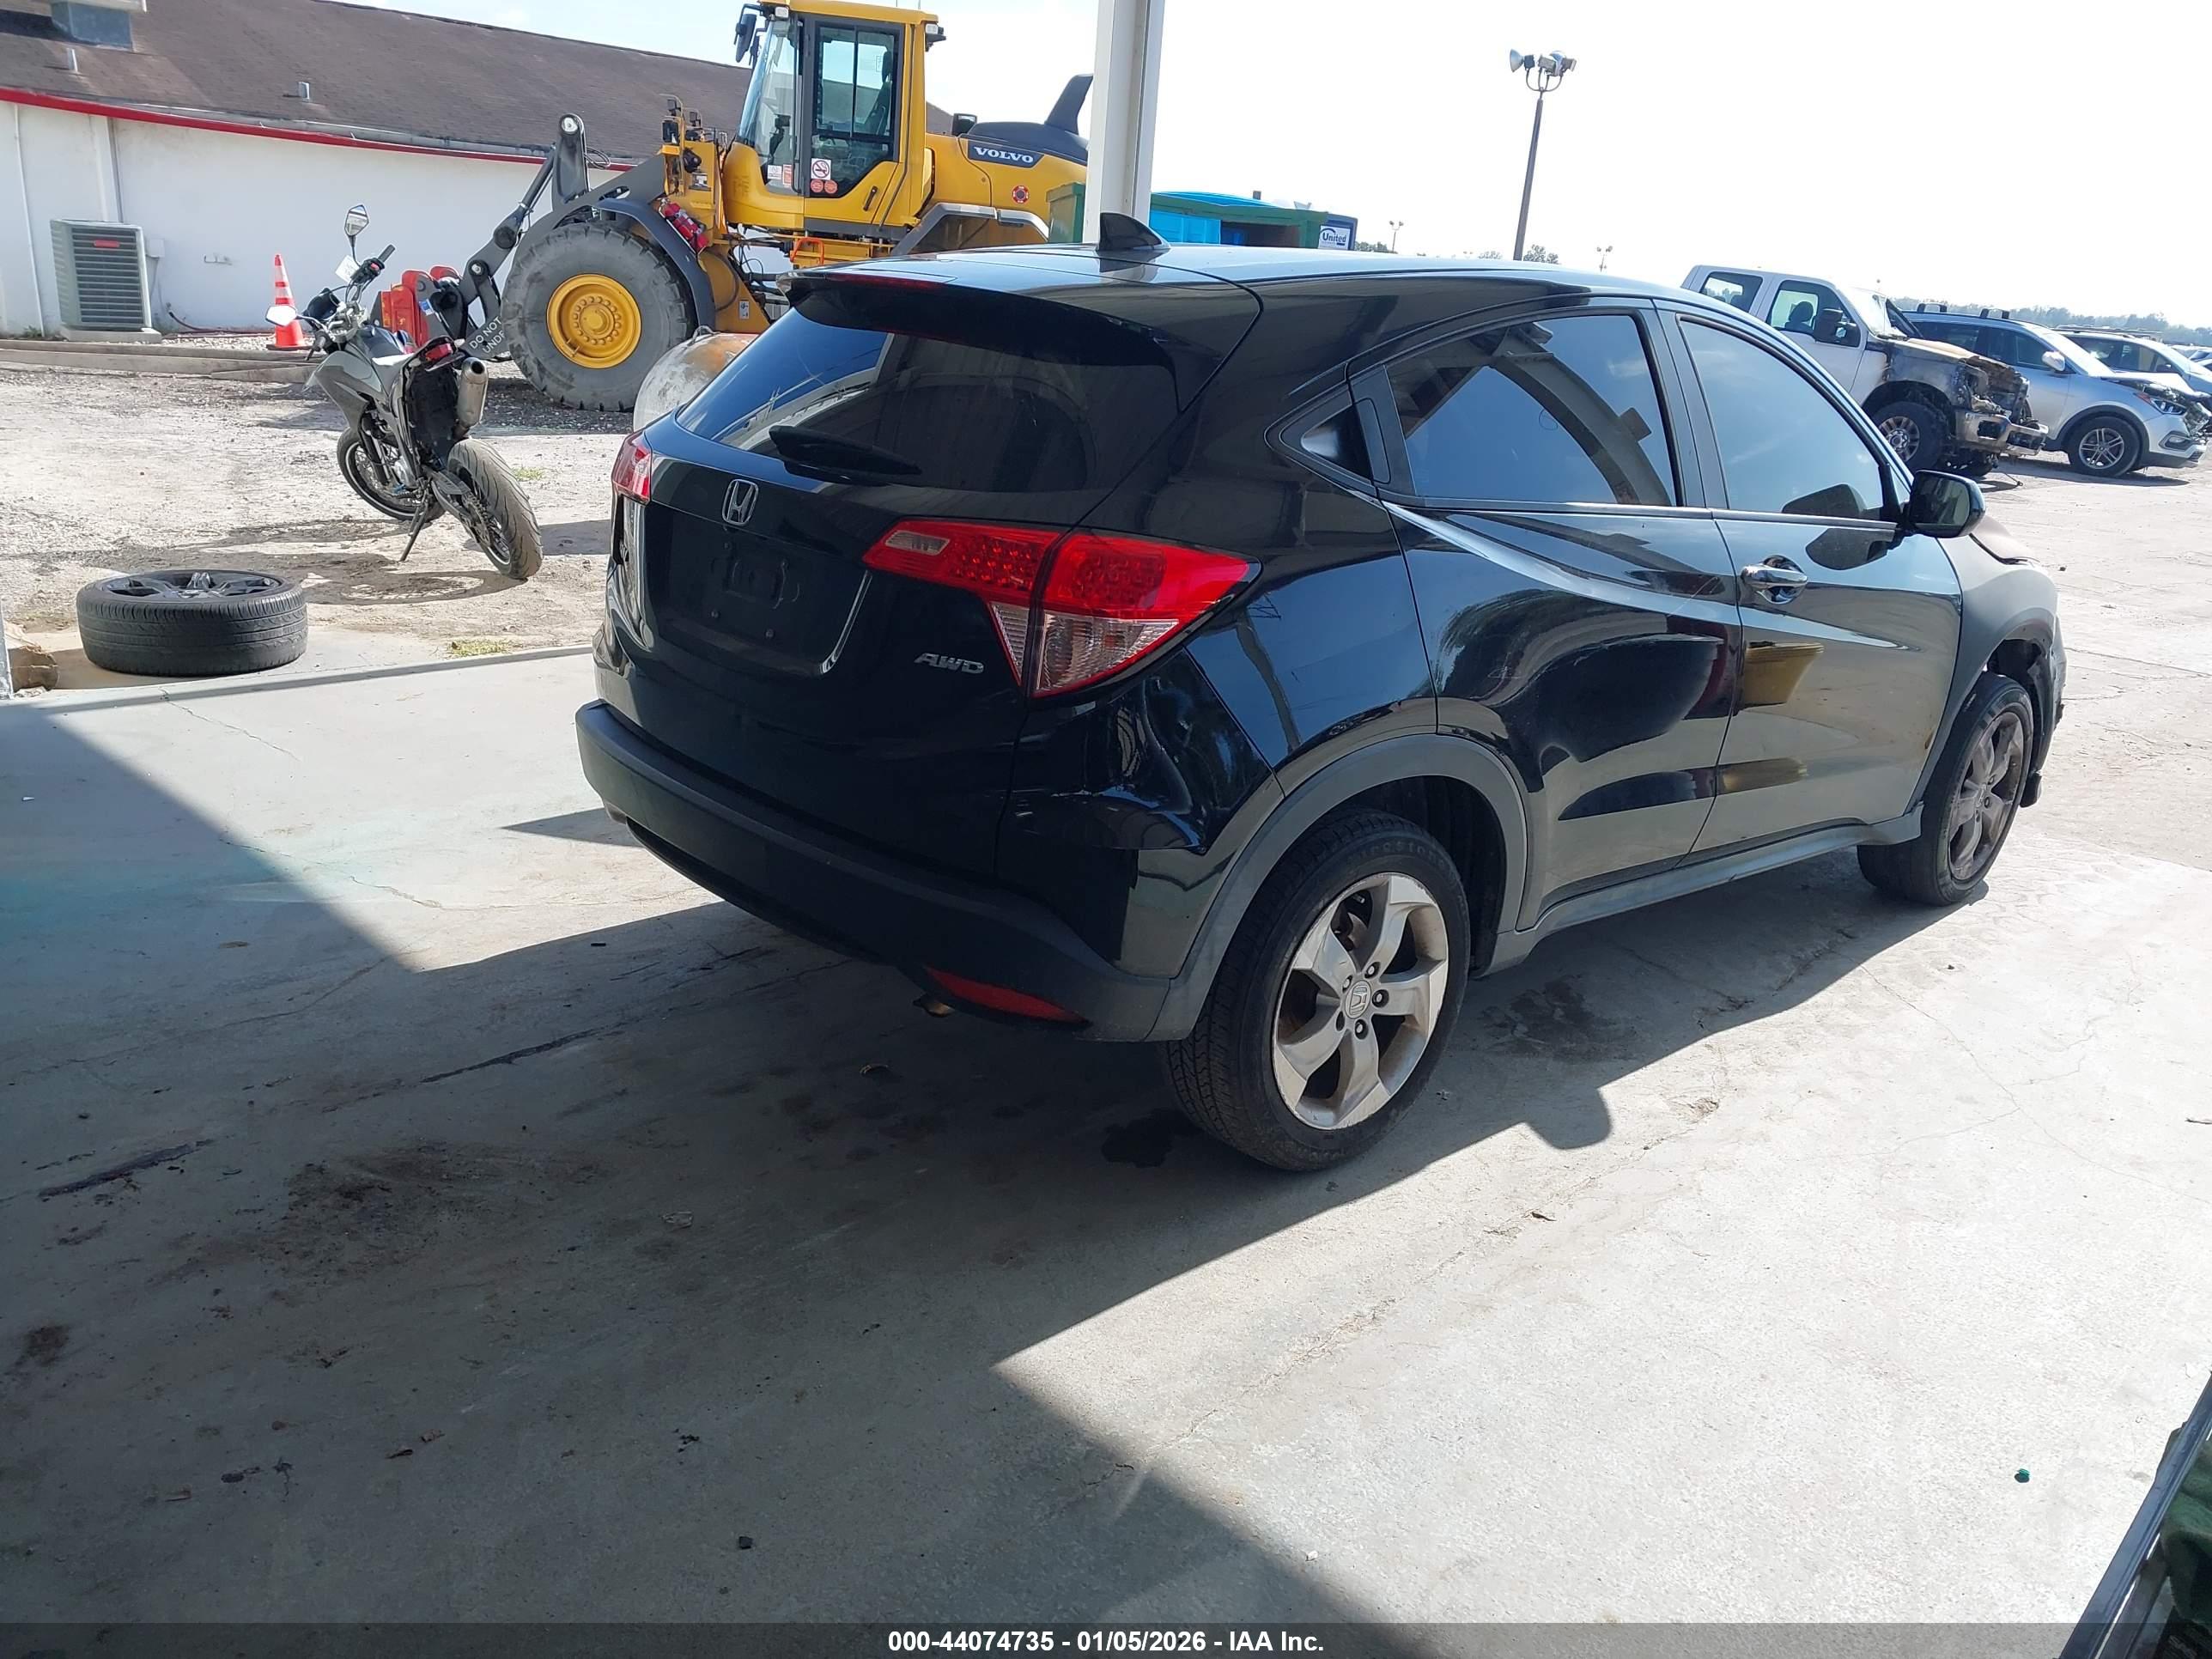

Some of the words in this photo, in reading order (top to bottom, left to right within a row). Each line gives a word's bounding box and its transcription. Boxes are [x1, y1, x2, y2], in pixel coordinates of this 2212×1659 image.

[974, 146, 1033, 163] VOLVO
[1322, 232, 1347, 243] United
[469, 335, 484, 349] DO
[483, 316, 501, 337] NOT
[913, 652, 984, 674] AWD
